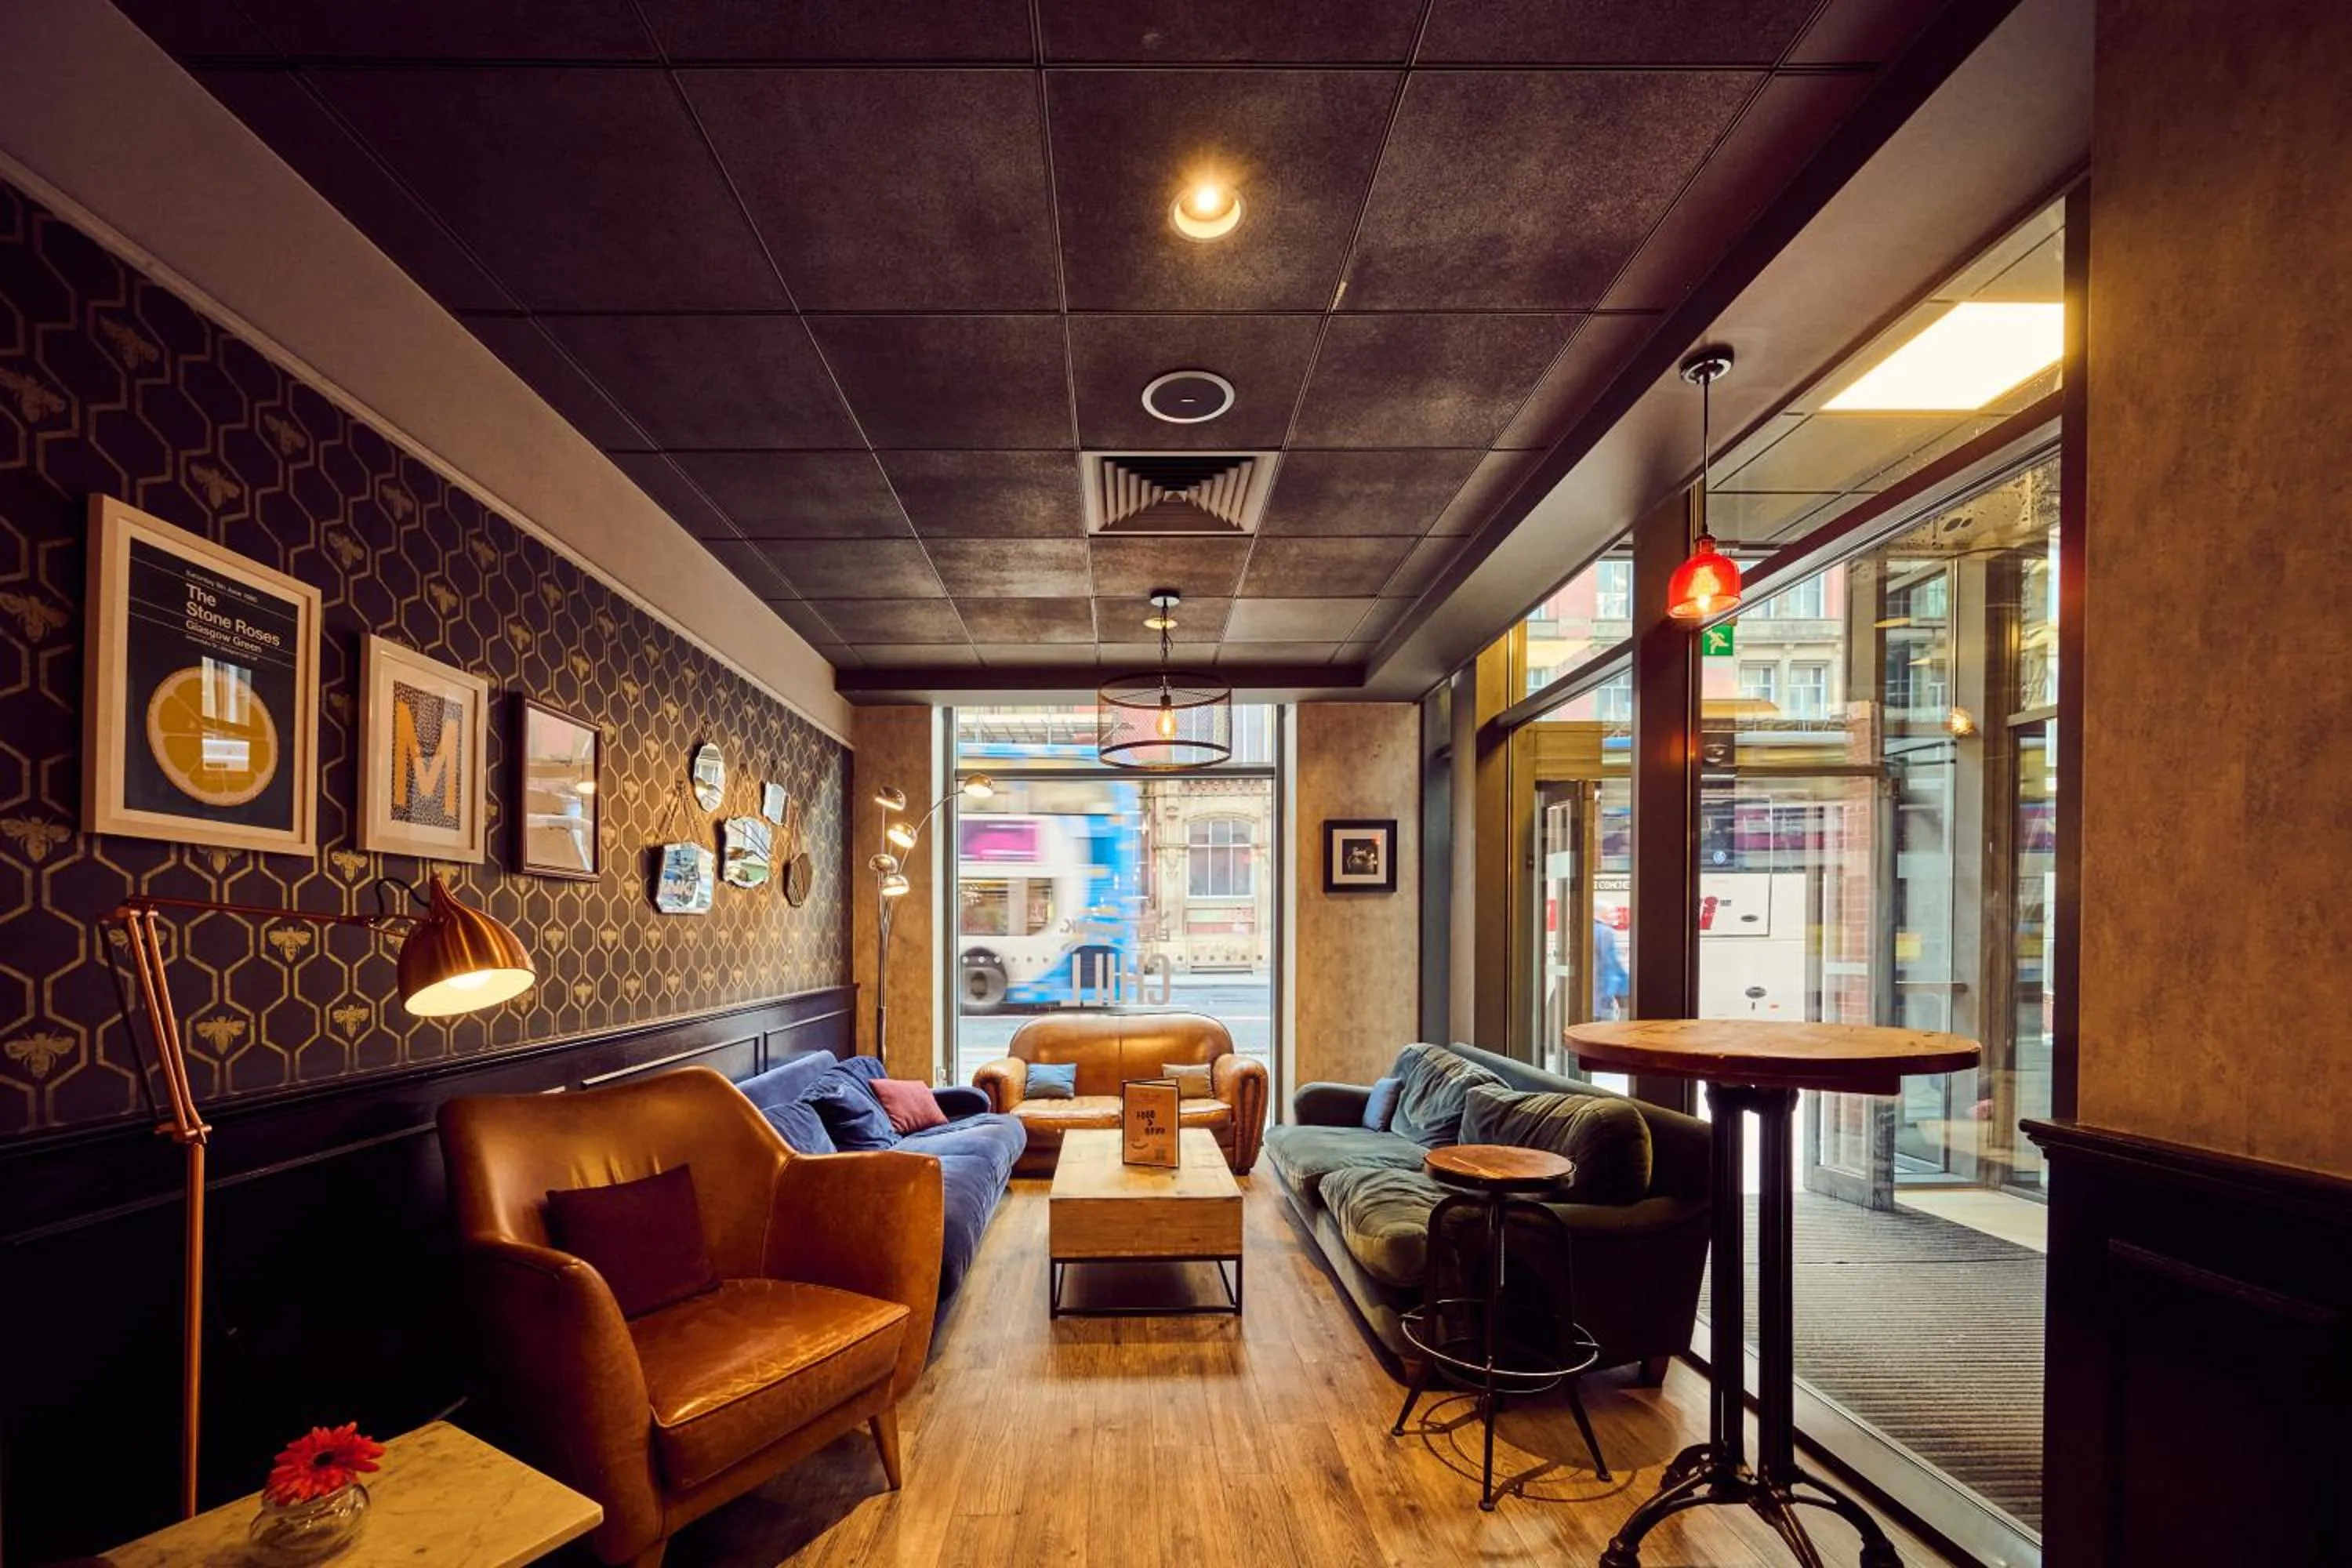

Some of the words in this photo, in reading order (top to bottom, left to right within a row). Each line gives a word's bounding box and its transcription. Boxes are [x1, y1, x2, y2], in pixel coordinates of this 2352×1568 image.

[185, 583, 216, 607] The
[185, 619, 231, 642] Glasgow
[232, 635, 263, 654] Green
[186, 601, 231, 629] Stone
[235, 618, 280, 647] Roses
[394, 701, 459, 819] M
